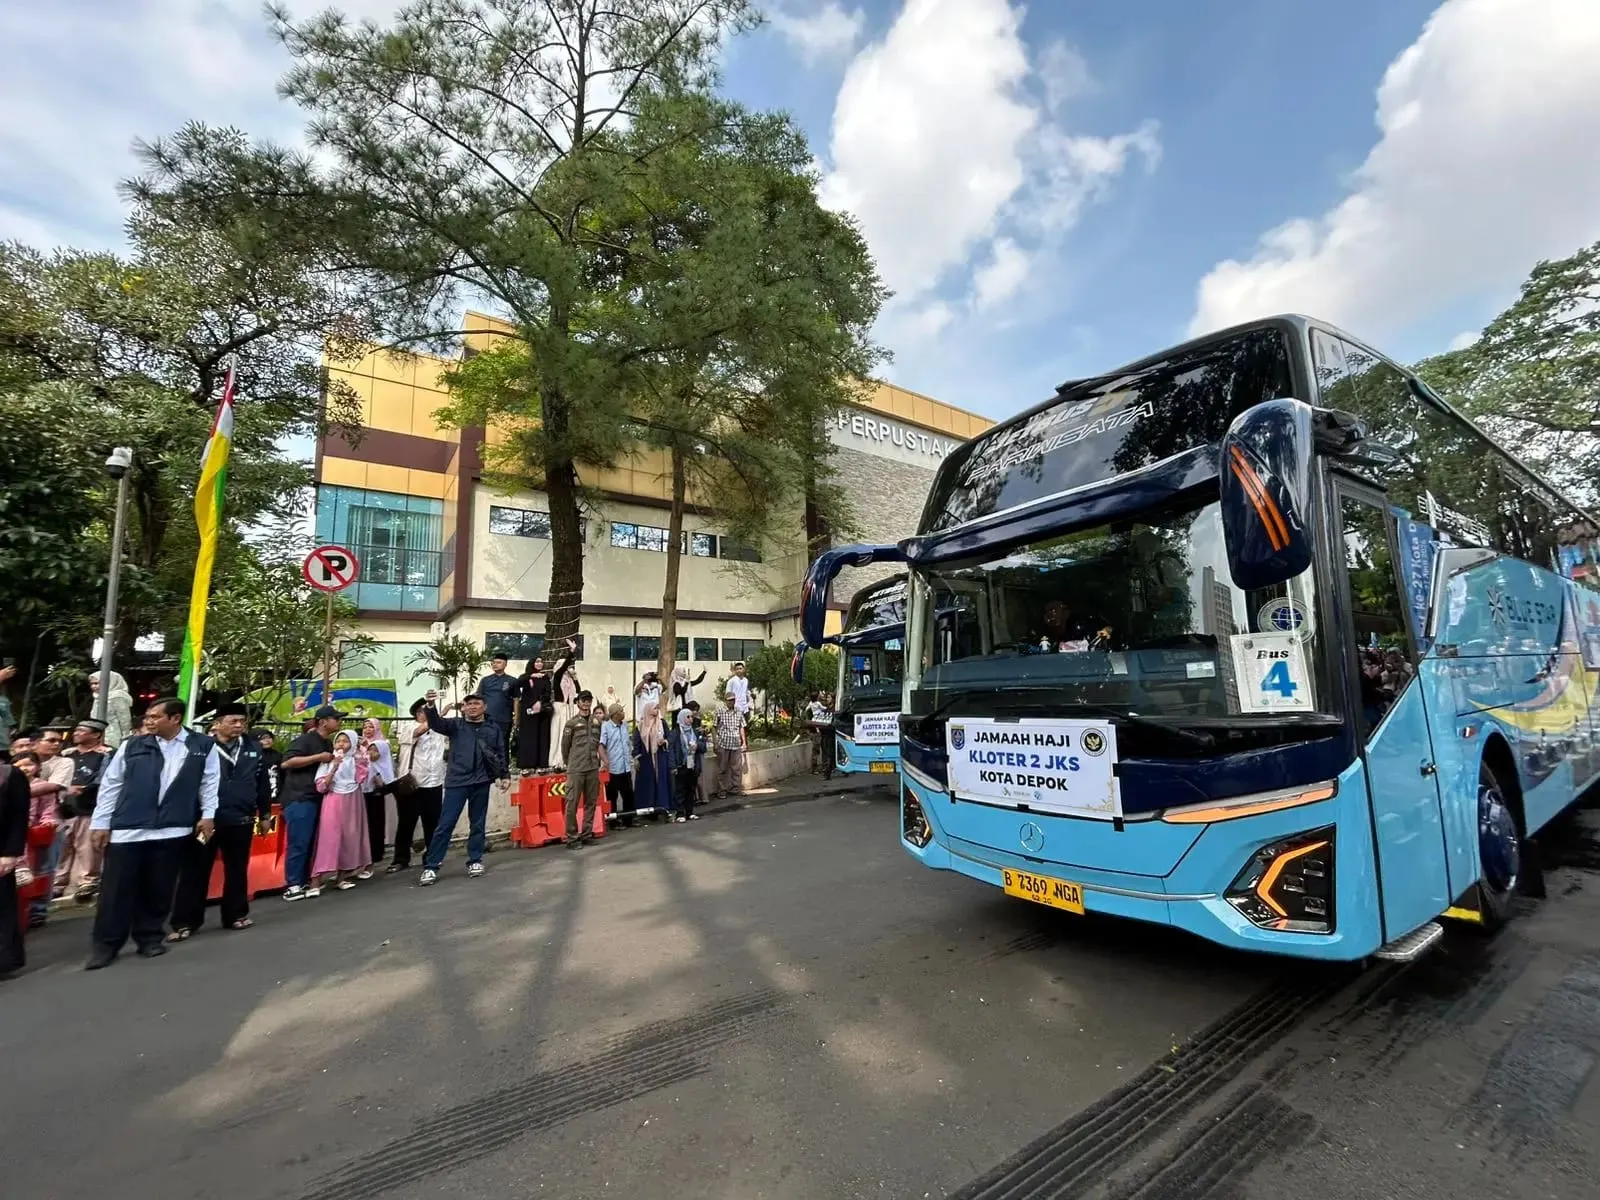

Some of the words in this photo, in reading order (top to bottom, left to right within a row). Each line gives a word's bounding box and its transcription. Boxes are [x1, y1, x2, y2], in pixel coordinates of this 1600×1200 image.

[323, 556, 347, 580] P
[1256, 649, 1289, 660] Bus
[1260, 661, 1298, 698] 4
[973, 731, 1031, 746] JAMAAH
[1034, 734, 1070, 748] HAJI
[969, 749, 1027, 768] KLOTER
[1030, 754, 1041, 769] 2
[1044, 754, 1081, 772] JKS
[979, 769, 1015, 786] KOTA
[1016, 773, 1068, 791] DEPOK
[1004, 871, 1012, 887] B
[1054, 882, 1081, 905] NGA
